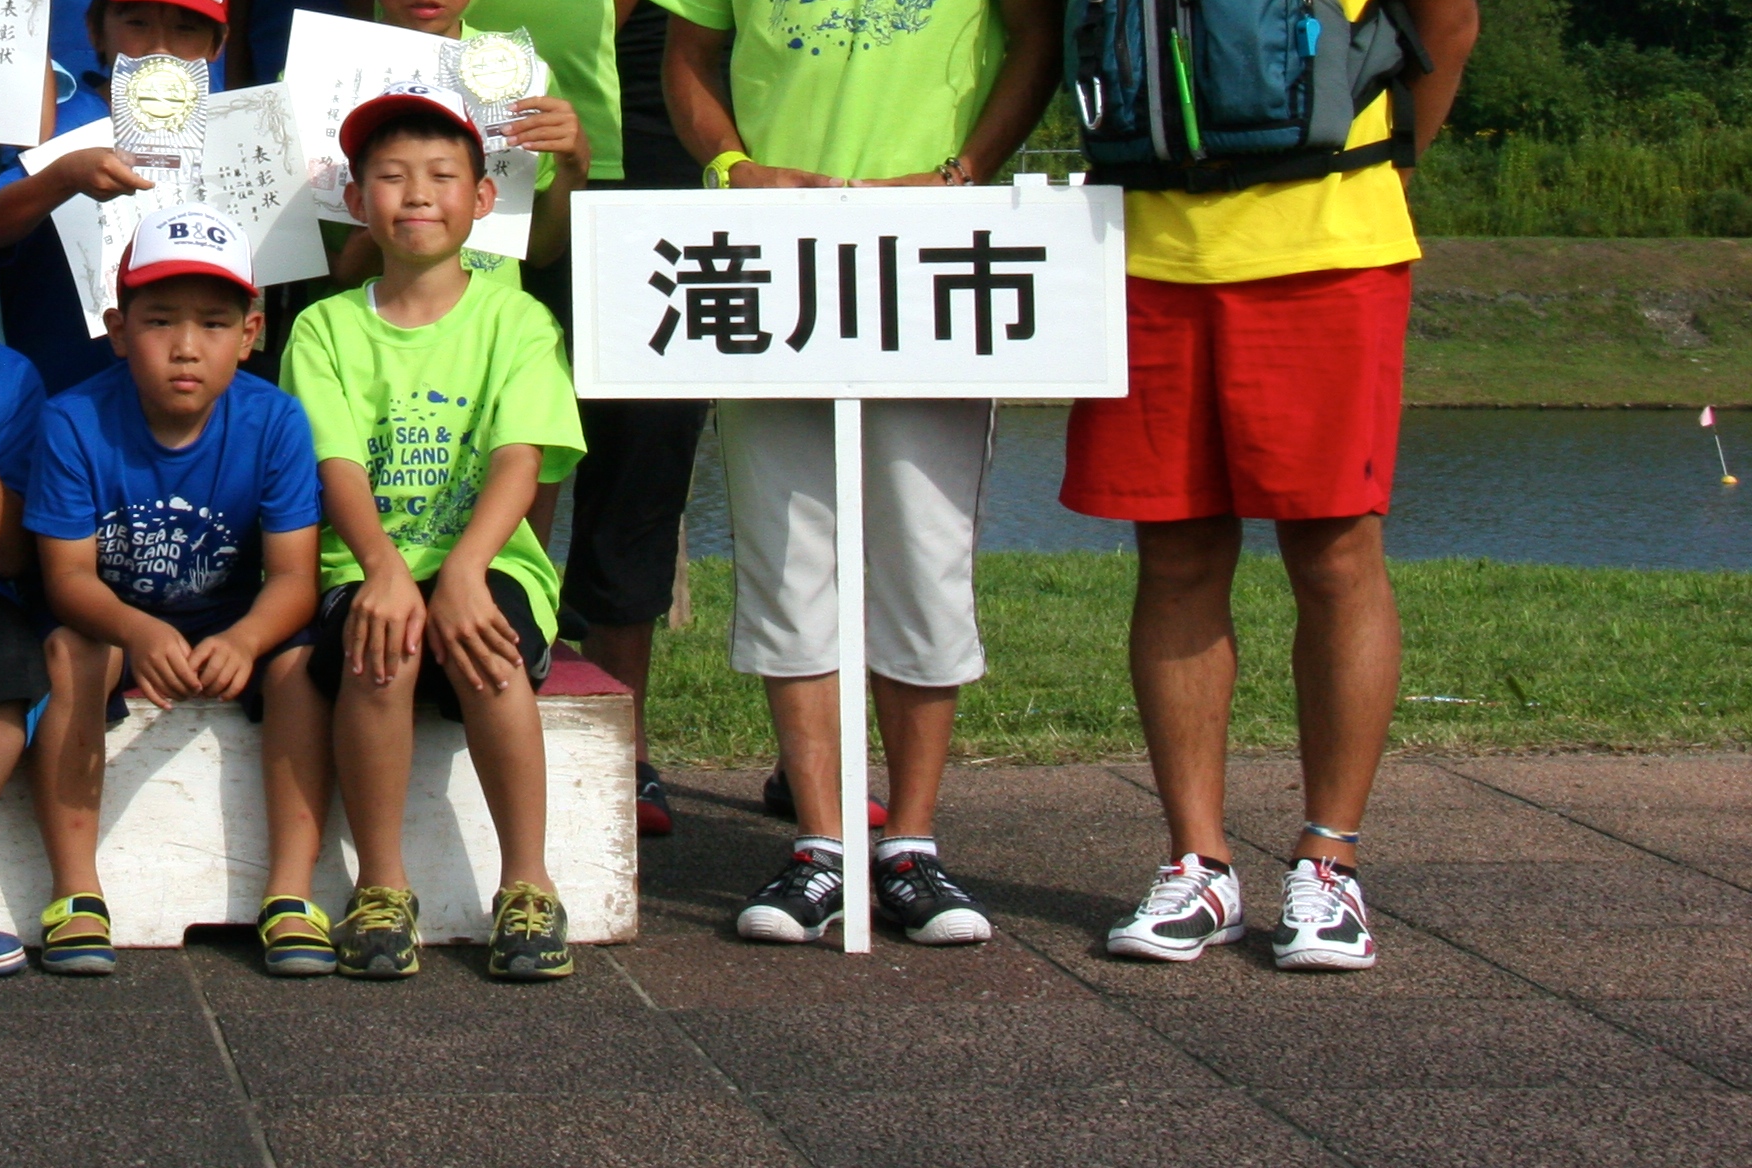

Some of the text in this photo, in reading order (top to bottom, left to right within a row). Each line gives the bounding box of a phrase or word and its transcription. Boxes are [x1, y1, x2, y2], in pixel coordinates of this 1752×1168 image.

[252, 145, 281, 209] 表彰状
[168, 221, 227, 245] B&G
[647, 229, 1048, 357] 滝川市
[395, 426, 451, 444] SEA &
[401, 447, 449, 465] LAND
[378, 467, 449, 486] DATION
[96, 523, 189, 546] LUE SEA &
[96, 537, 181, 560] EEN LAND
[100, 554, 179, 579] NDATION
